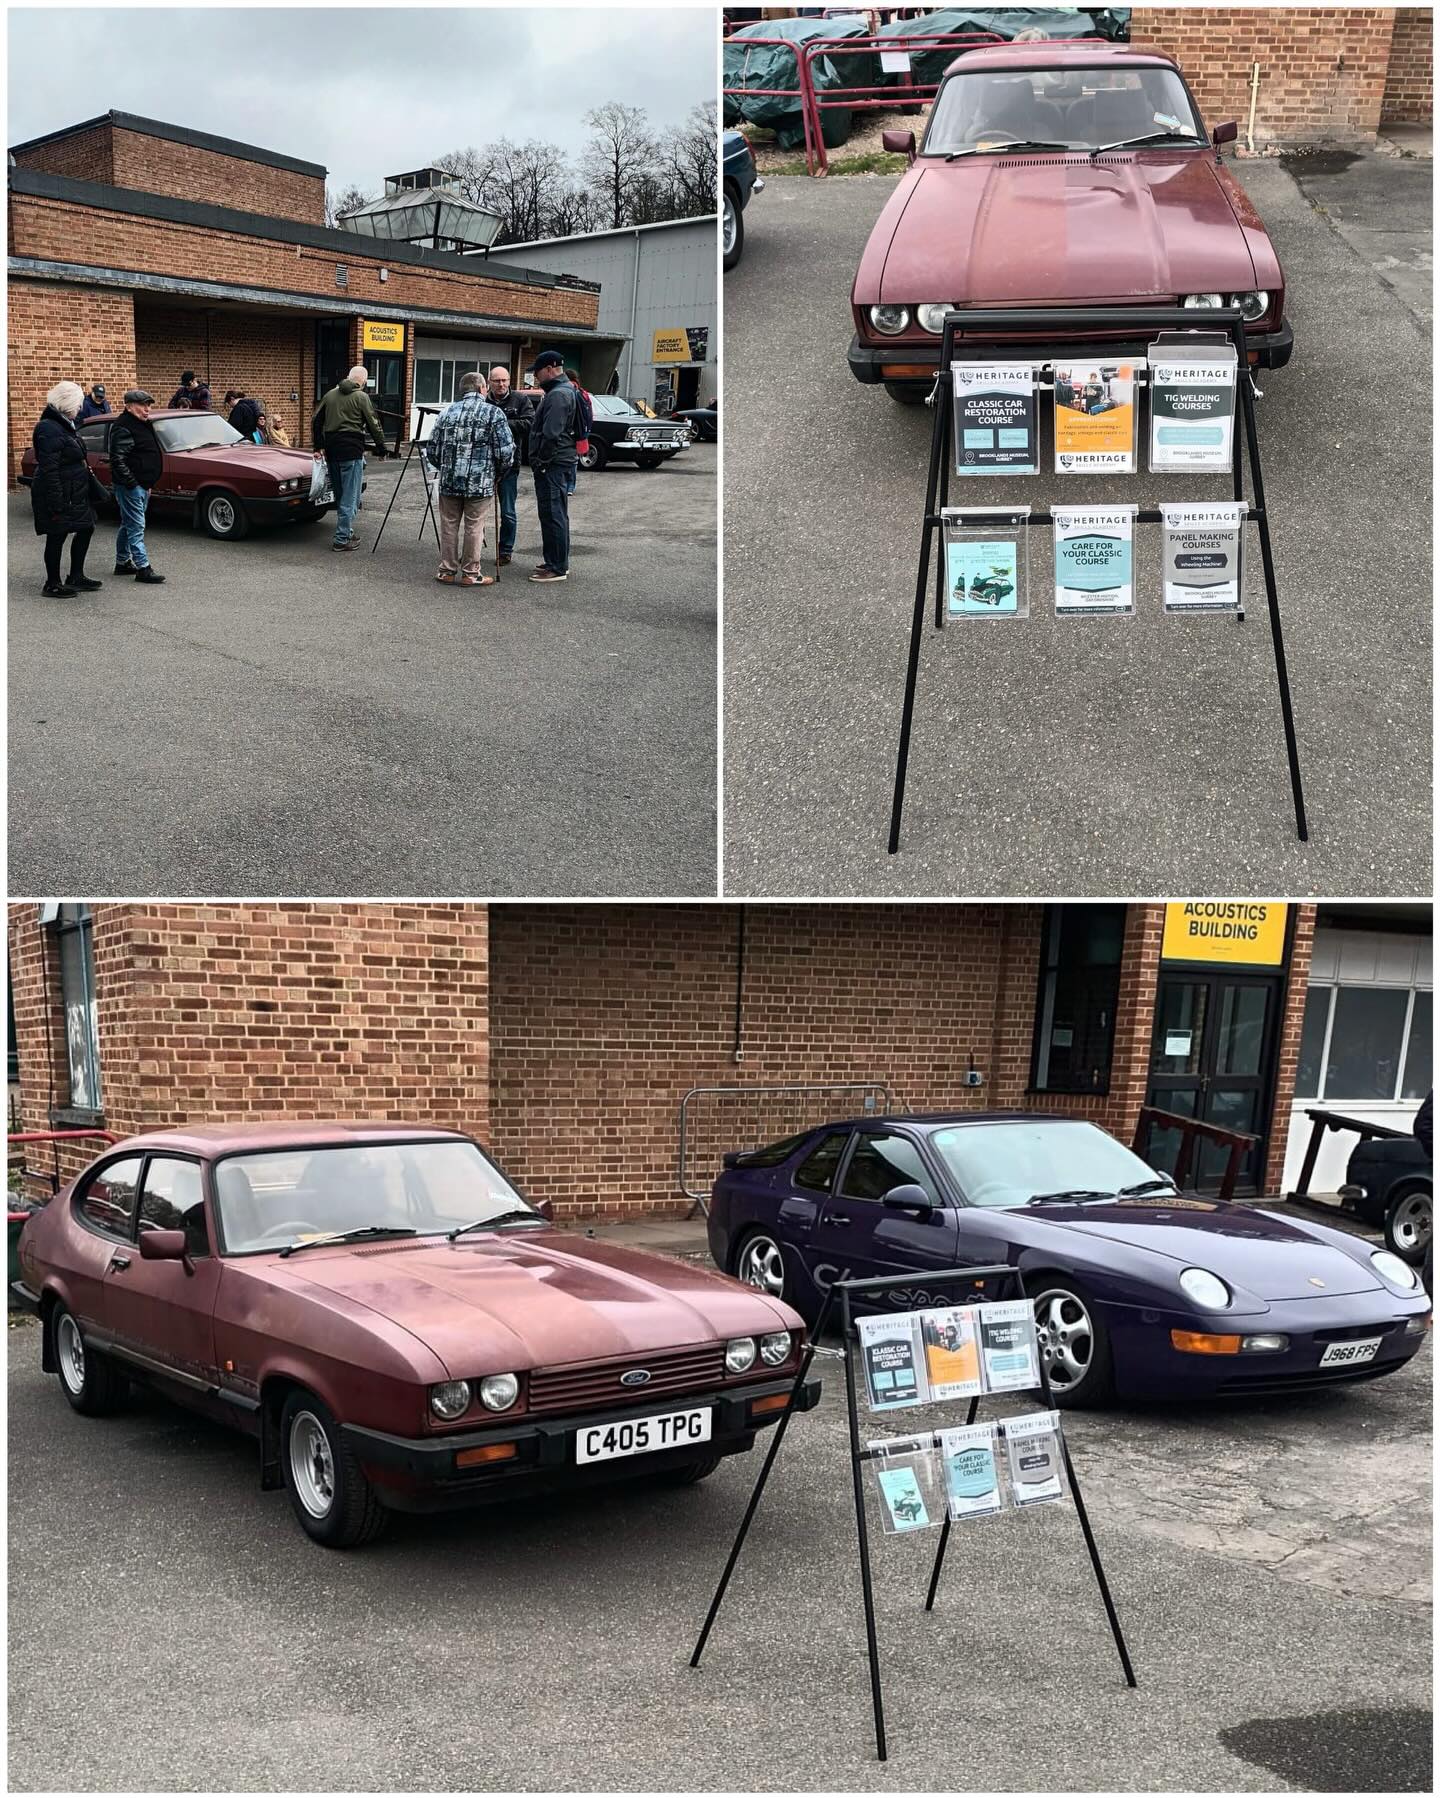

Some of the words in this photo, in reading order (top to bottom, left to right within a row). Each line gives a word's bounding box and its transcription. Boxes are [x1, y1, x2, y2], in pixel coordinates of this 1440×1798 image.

[370, 326, 398, 334] ACOUSTICS
[1184, 903, 1266, 921] ACOUSTICS
[1189, 920, 1258, 940] BUILDING
[996, 1334, 1018, 1342] COURSES
[1324, 1347, 1355, 1361] J968
[1355, 1343, 1378, 1358] FPS
[873, 1352, 910, 1362] RESTORATION
[881, 1360, 904, 1368] COURSE
[627, 1373, 644, 1383] Ford
[948, 1383, 978, 1391] HERITAGE
[1020, 1420, 1050, 1429] HERITAGE
[586, 1422, 649, 1456] C405
[658, 1413, 702, 1443] TPG
[961, 1431, 989, 1440] HERITAGE
[954, 1464, 970, 1472] YOUR
[963, 1468, 984, 1477] COURSE
